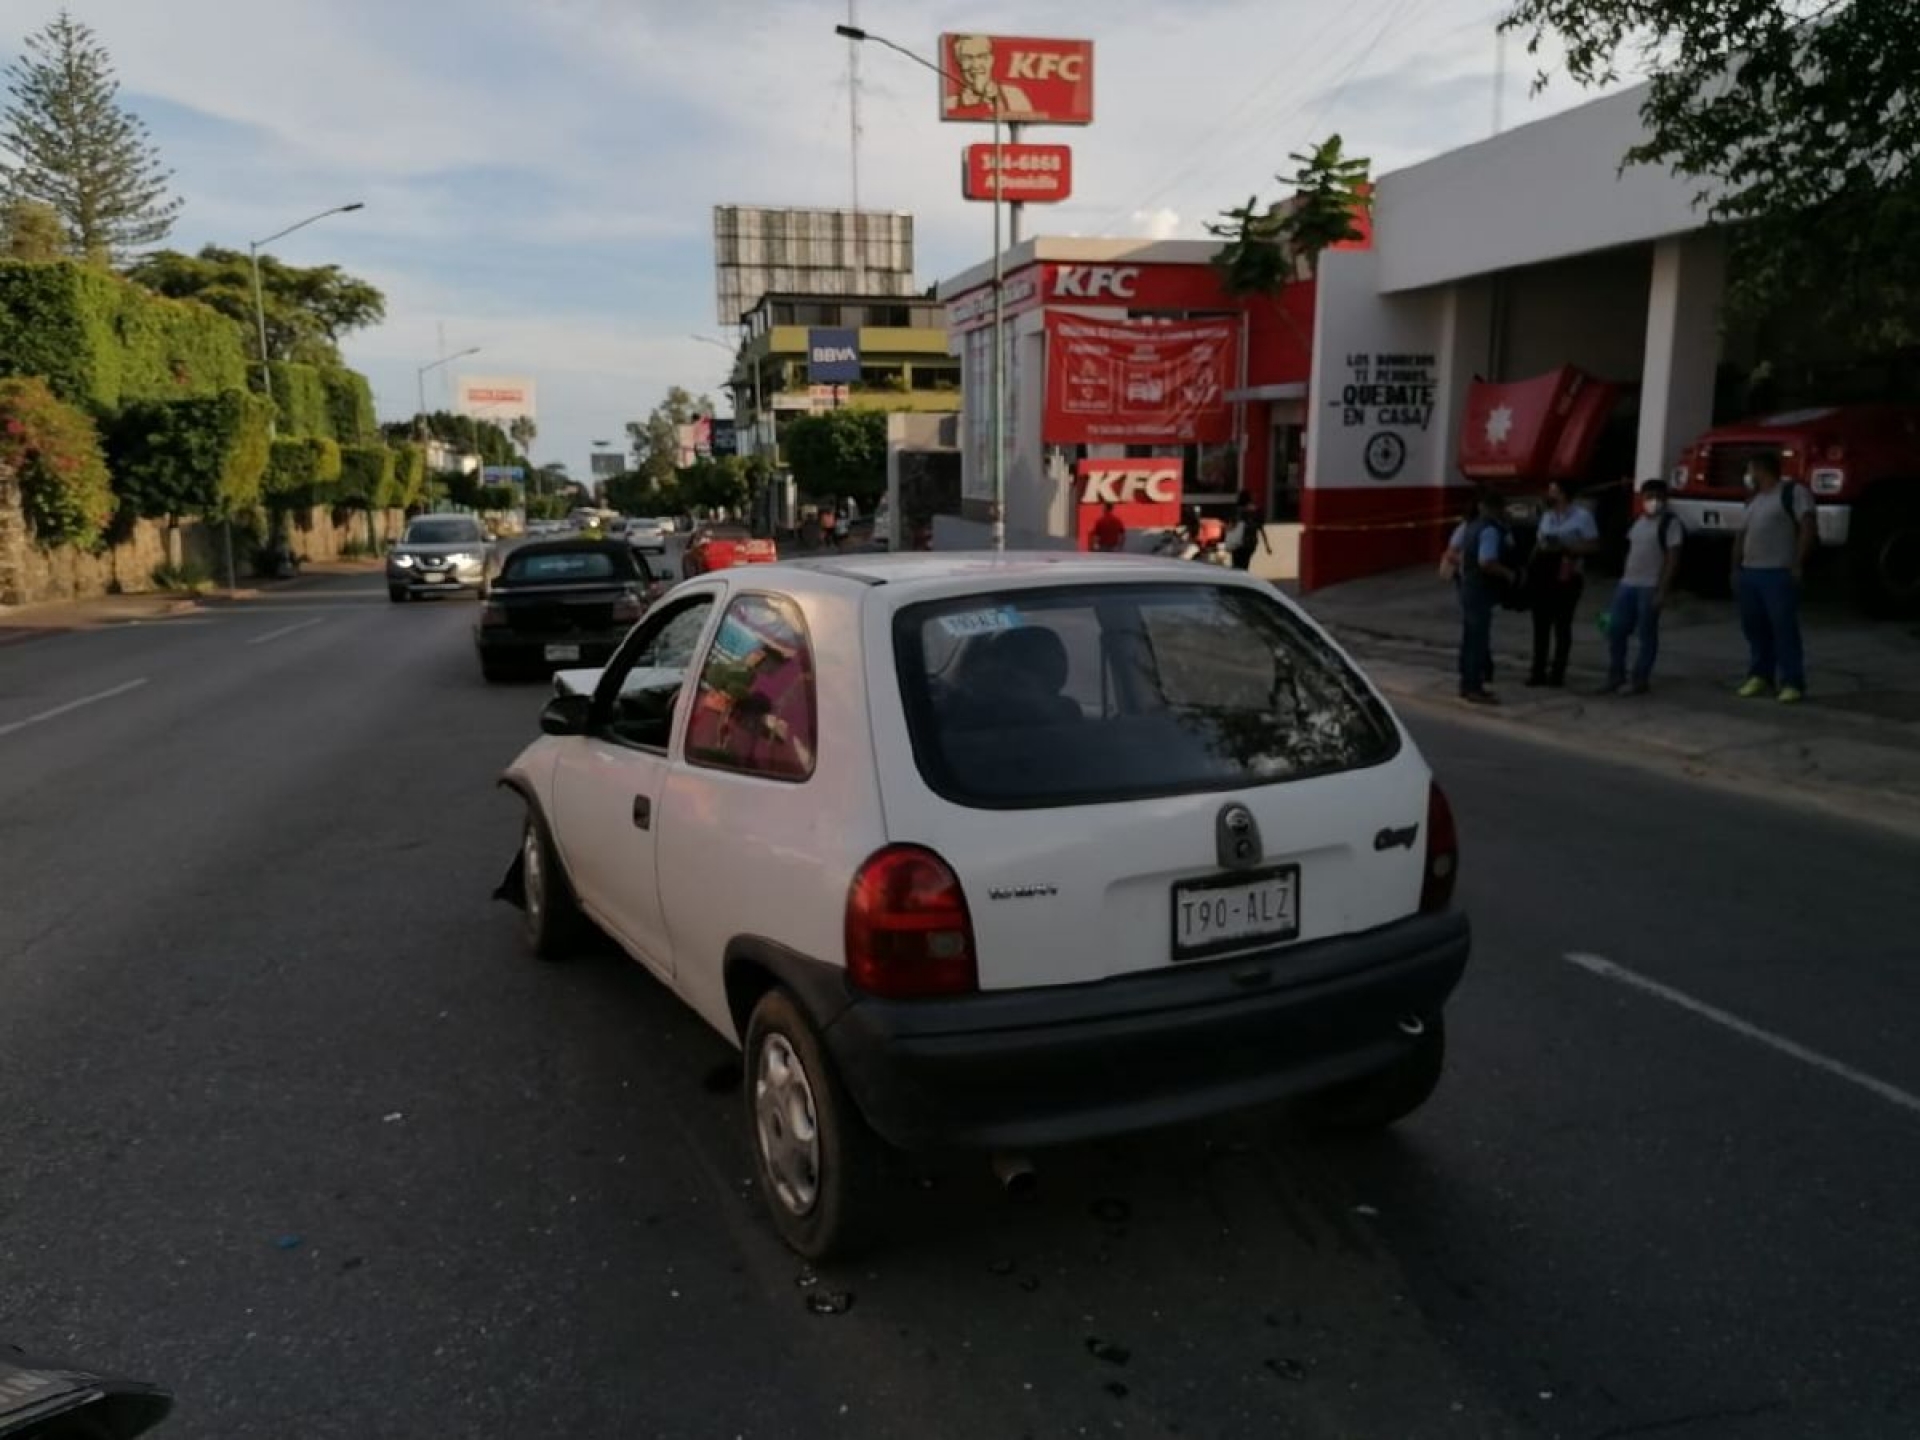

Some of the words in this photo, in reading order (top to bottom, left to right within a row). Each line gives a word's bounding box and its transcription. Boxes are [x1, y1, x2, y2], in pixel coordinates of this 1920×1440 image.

[1006, 51, 1083, 81] KFC
[1053, 266, 1140, 297] KFC
[812, 346, 857, 363] BBVA
[1343, 408, 1364, 426] EN
[1082, 469, 1177, 503] KFC
[1182, 887, 1289, 936] T90-ALZ
